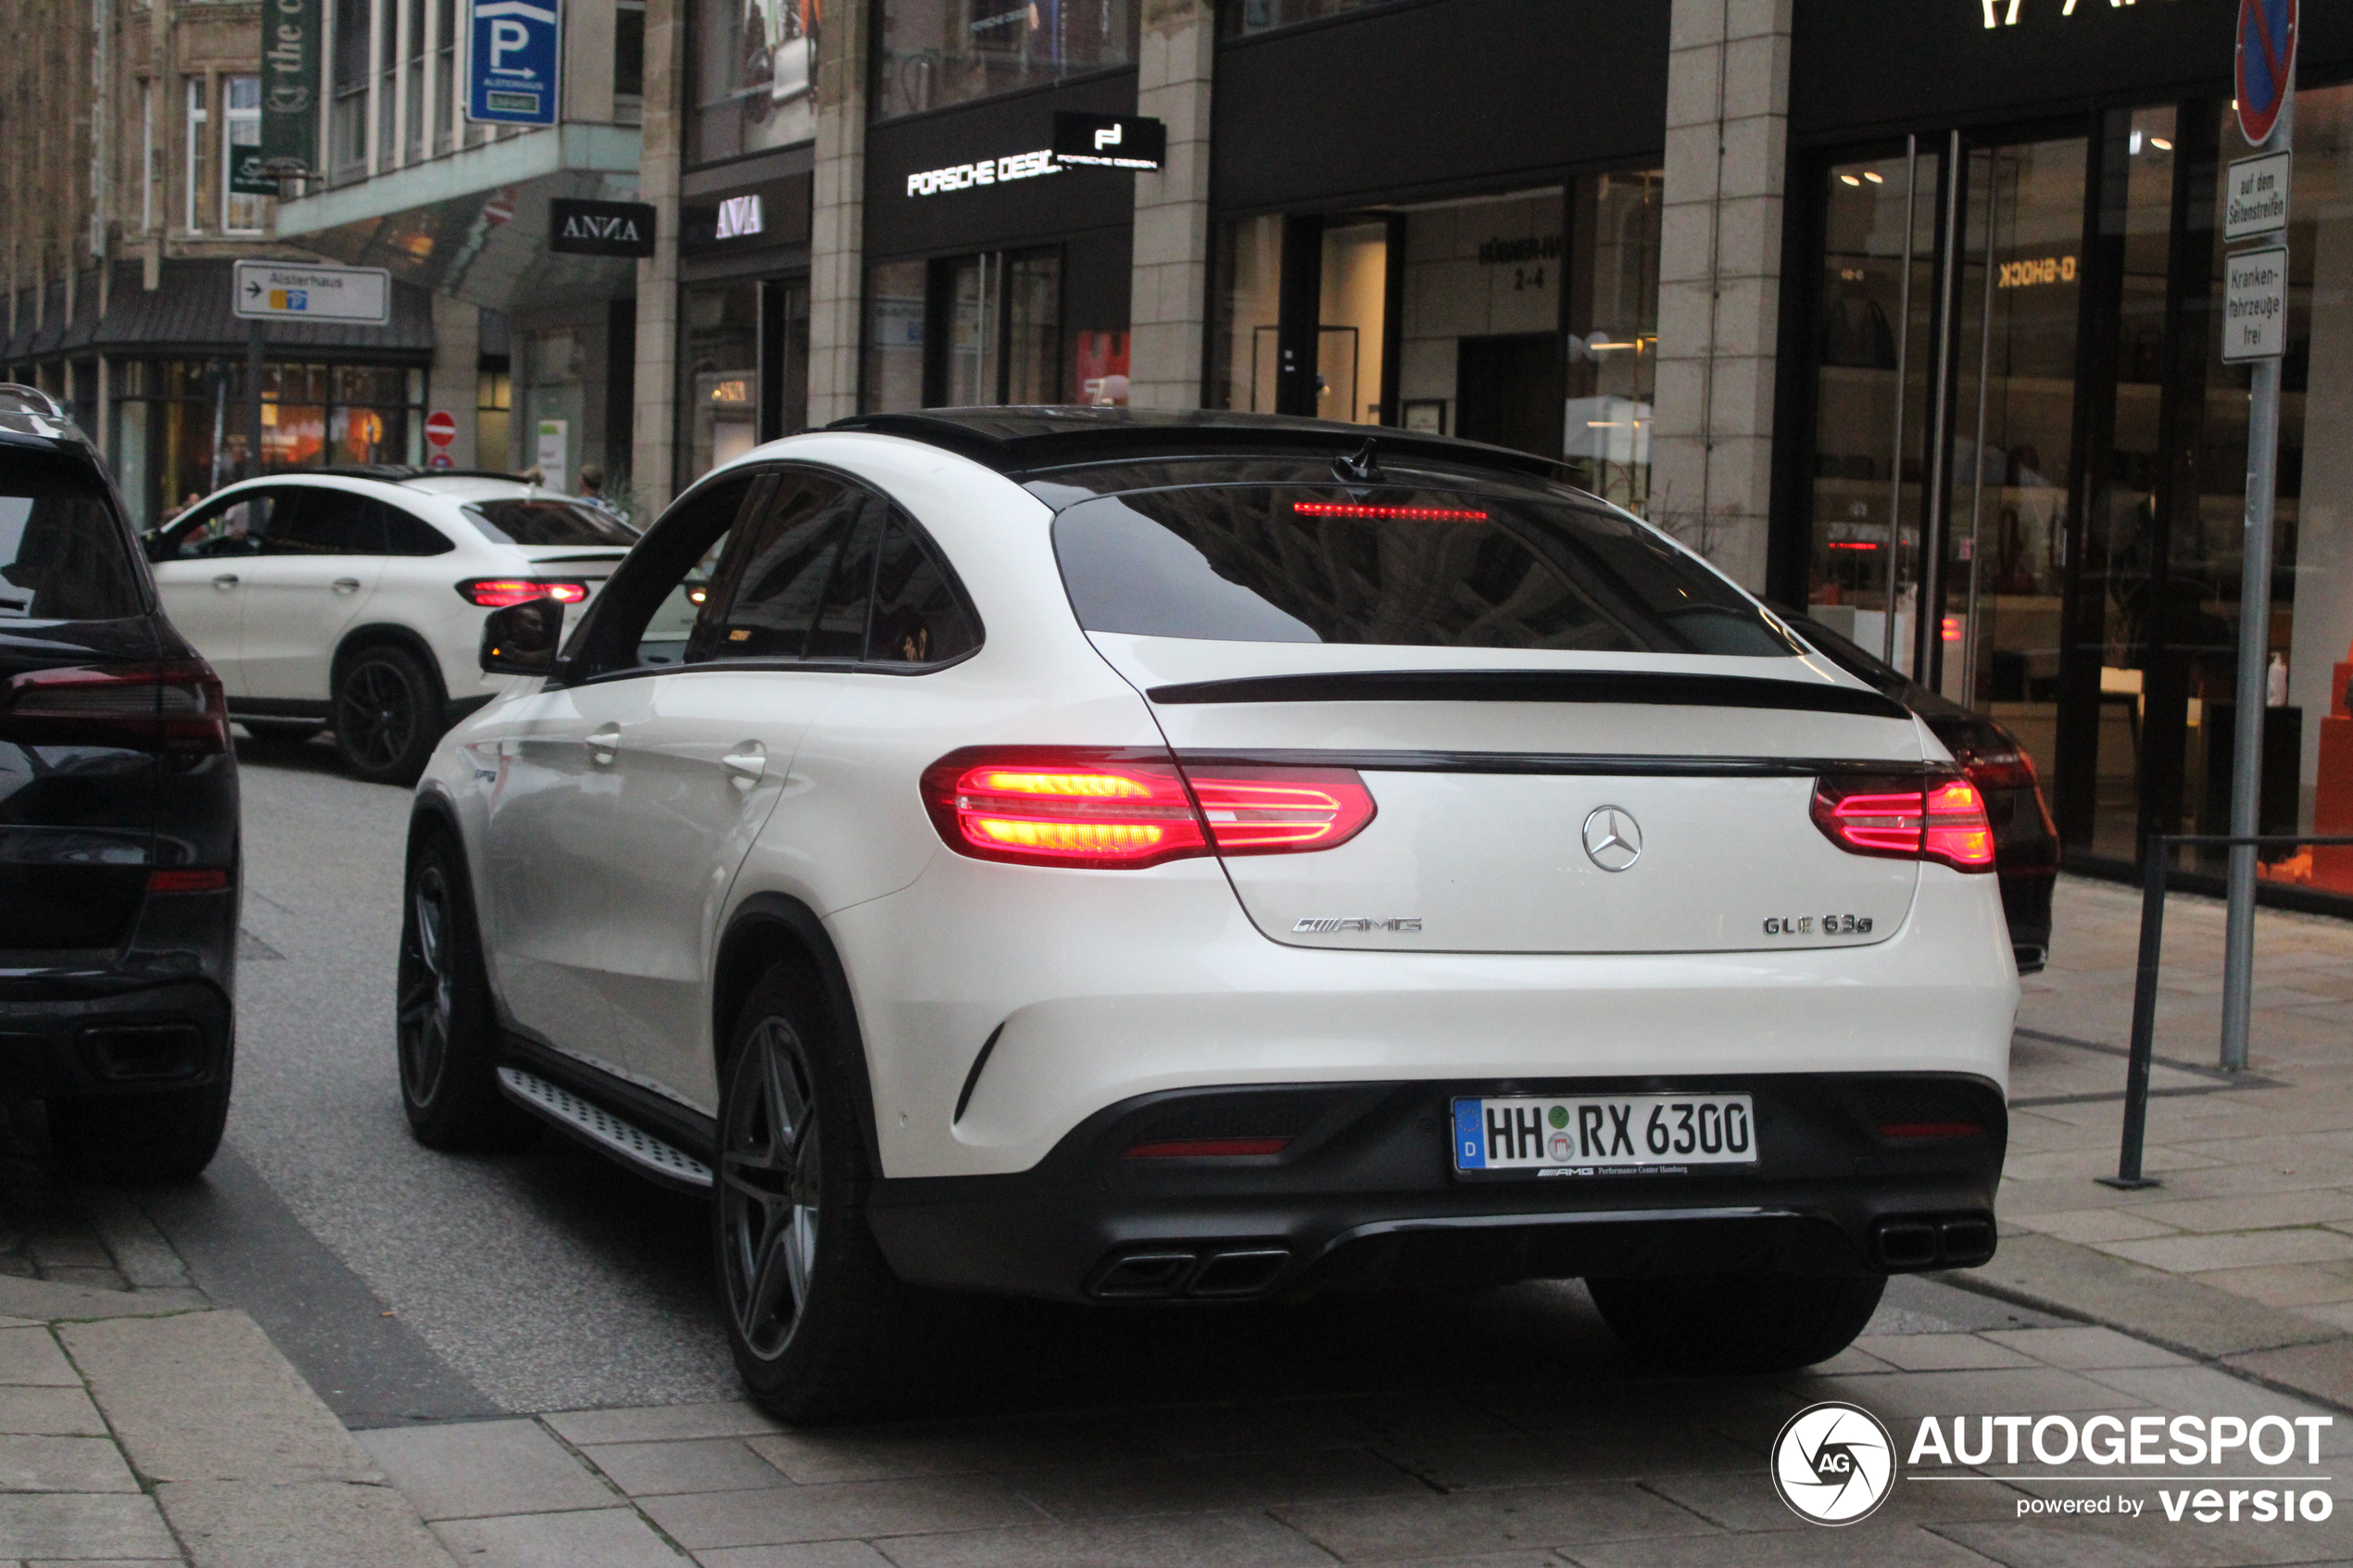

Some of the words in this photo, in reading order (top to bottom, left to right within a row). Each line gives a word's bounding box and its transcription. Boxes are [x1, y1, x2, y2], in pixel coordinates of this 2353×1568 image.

[268, 23, 303, 72] the
[490, 19, 529, 67] P
[1057, 154, 1114, 167] PORSCHE
[1114, 157, 1158, 169] DESIGN
[908, 160, 996, 196] PORSCHE
[2240, 173, 2254, 195] auf
[2257, 171, 2274, 192] dem
[2228, 196, 2284, 225] Seitenstreifen
[2231, 267, 2280, 289] Kranken-
[2229, 296, 2280, 320] fahrzeuge
[2243, 324, 2262, 345] frei
[1763, 916, 1814, 935] GLE
[1465, 1141, 1477, 1157] D
[1486, 1106, 1545, 1160] HH
[1578, 1104, 1635, 1157] RX
[1645, 1102, 1750, 1155] 6300
[1556, 1167, 1594, 1176] AMG
[1598, 1166, 1638, 1175] Performance
[1638, 1165, 1658, 1174] Center
[1659, 1164, 1688, 1174] Hamburg
